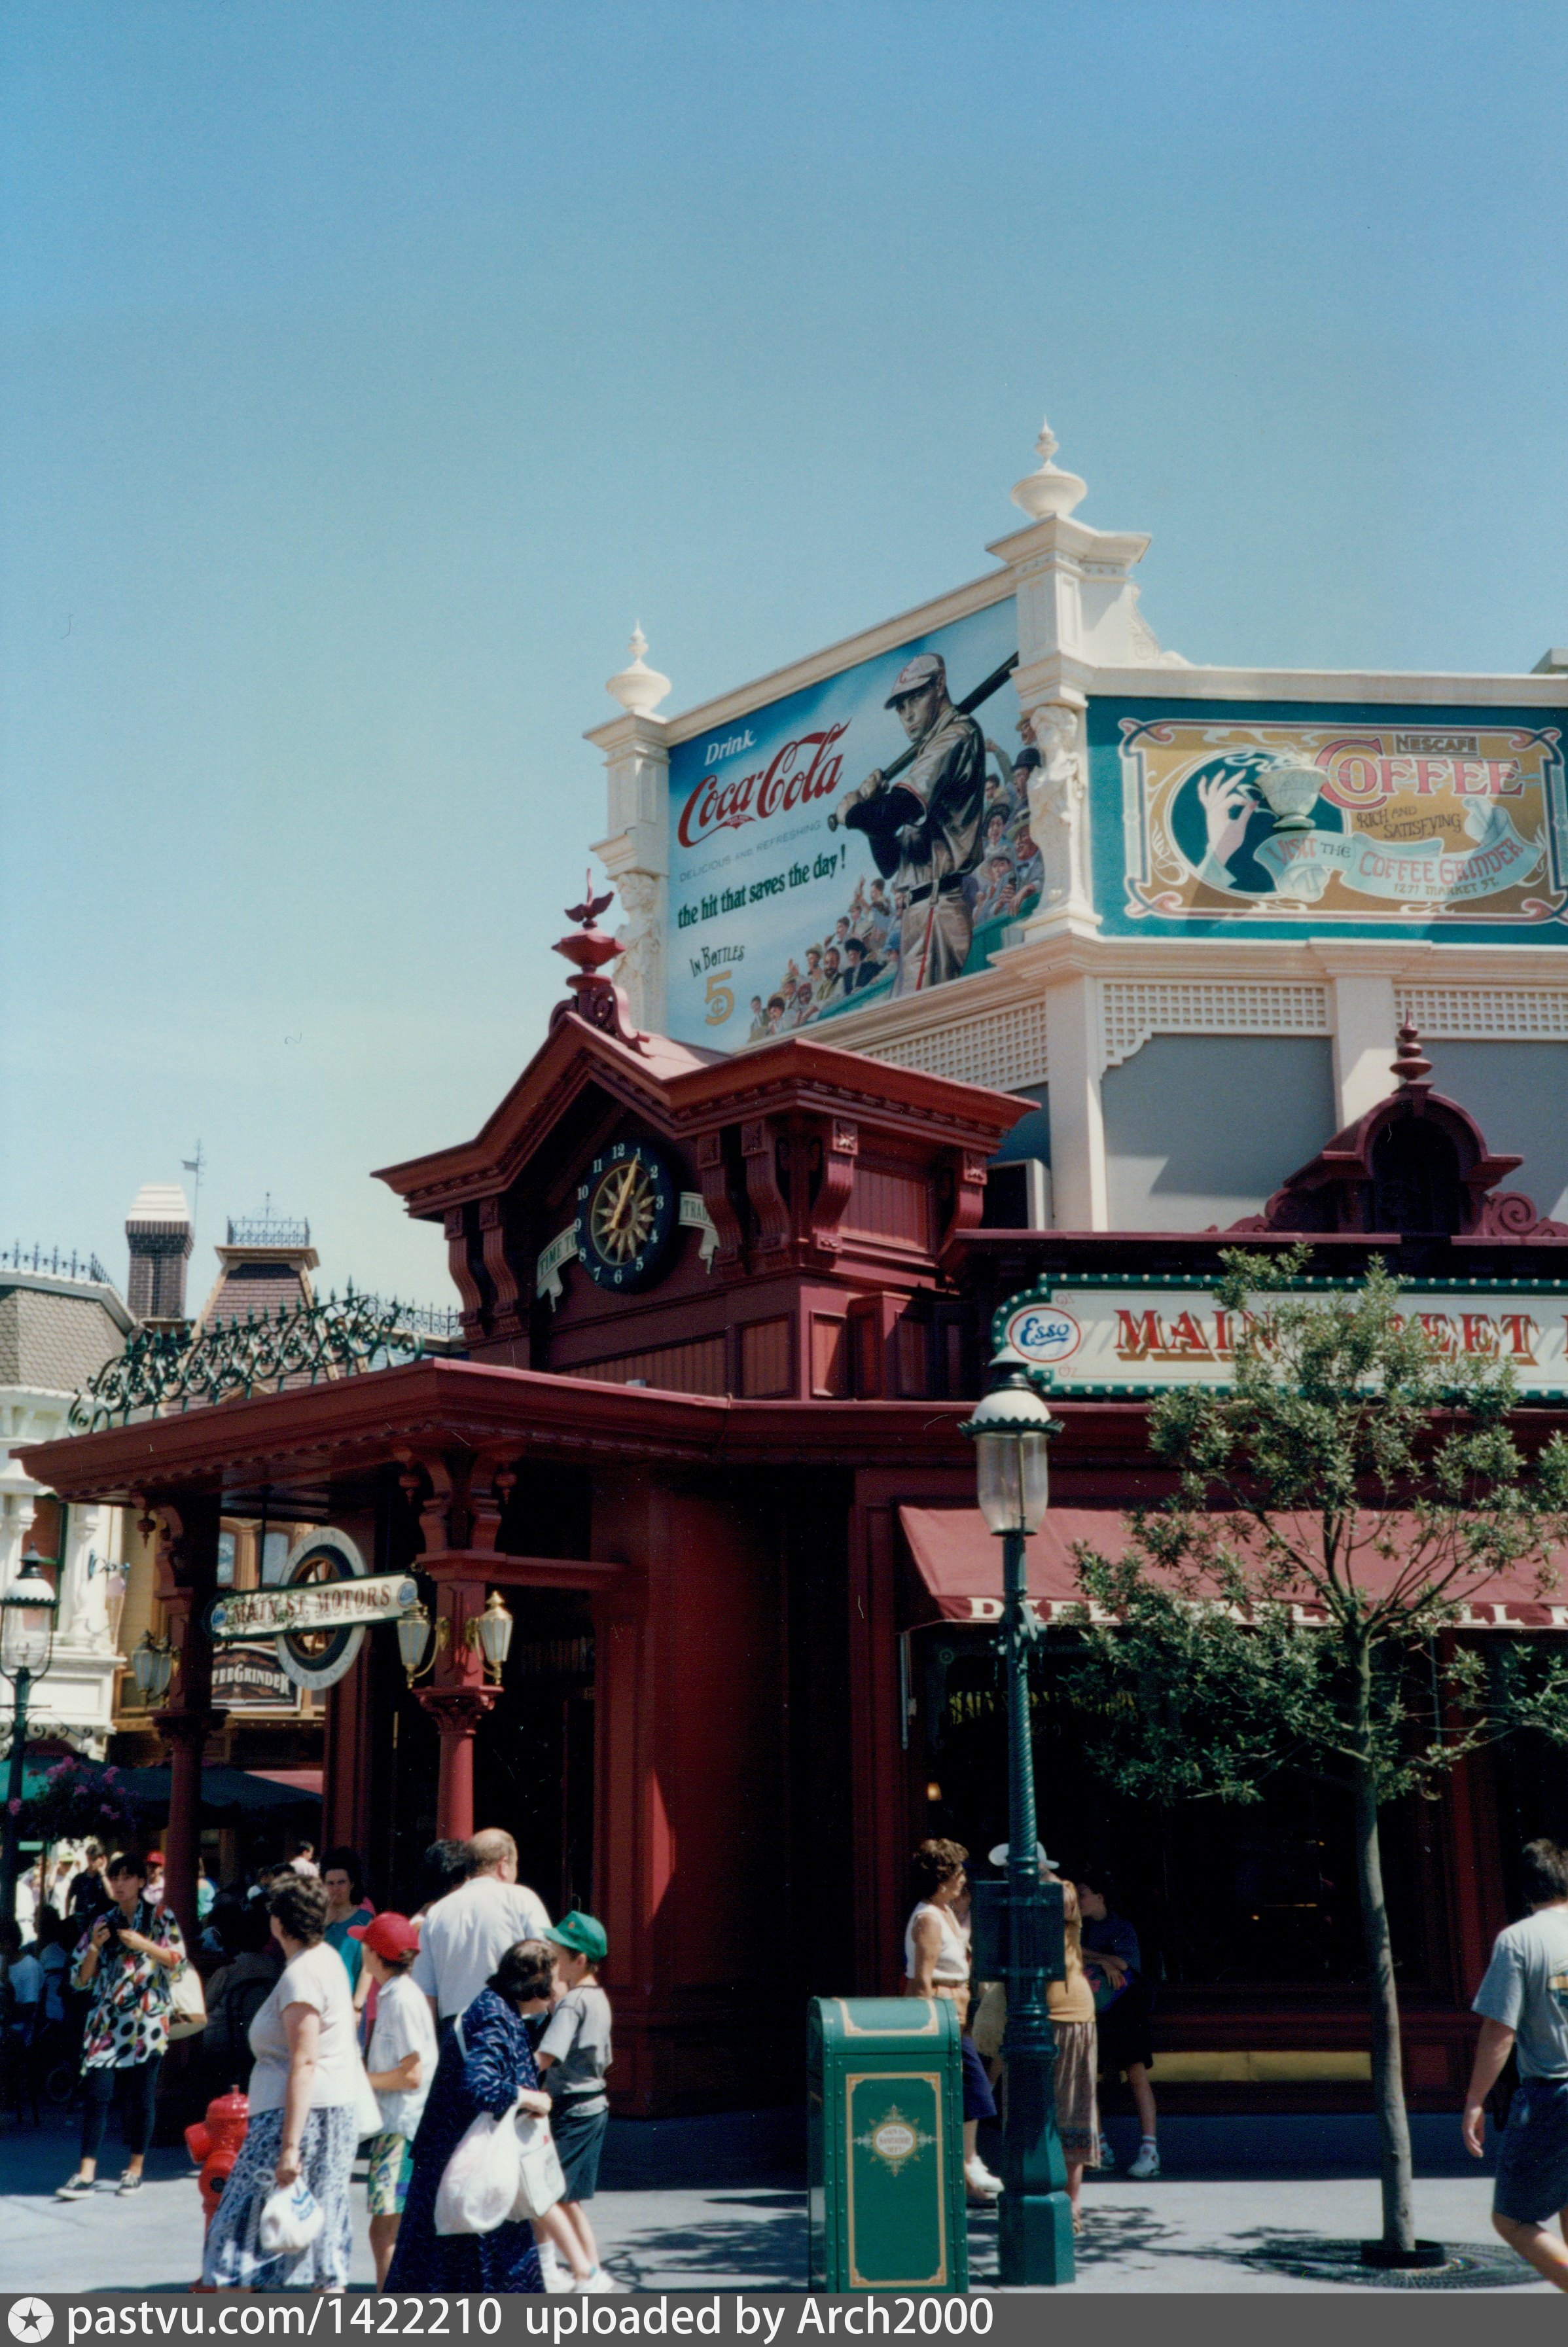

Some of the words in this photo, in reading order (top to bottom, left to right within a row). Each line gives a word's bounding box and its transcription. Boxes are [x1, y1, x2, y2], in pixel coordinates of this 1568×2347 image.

[704, 729, 757, 766] Drink
[677, 718, 851, 848] Coca-Cola
[1314, 738, 1524, 810] COFFEE
[1357, 807, 1388, 829] RICH
[1391, 806, 1417, 818] AND
[1383, 814, 1461, 839] SATISFYING
[680, 855, 732, 882] DELICIOUS
[736, 848, 754, 861] AND
[757, 820, 821, 853] REFRESHING
[1266, 837, 1317, 865] VISIT
[1320, 841, 1351, 858] THE
[1359, 850, 1434, 884] COFFEE
[1440, 836, 1524, 886] GRINDER
[678, 903, 698, 929] the
[701, 893, 718, 921] hit
[721, 885, 746, 913] that
[749, 873, 785, 903] saves
[789, 861, 810, 887] the
[690, 958, 702, 978] IN
[701, 945, 745, 971] BOTTLES
[612, 1143, 625, 1159] 12
[593, 1158, 602, 1173] 11
[650, 1165, 658, 1179] 2
[577, 1185, 588, 1200] 10
[656, 1195, 664, 1209] 3
[574, 1219, 582, 1232] 9
[650, 1229, 658, 1243] 4
[579, 1248, 586, 1262] 8
[635, 1256, 644, 1271] 5
[593, 1266, 601, 1280] 7
[614, 1269, 622, 1284] 6
[1020, 1317, 1070, 1346] Esso
[1114, 1310, 1278, 1360] MAIN
[315, 1584, 391, 1613] MOTORS
